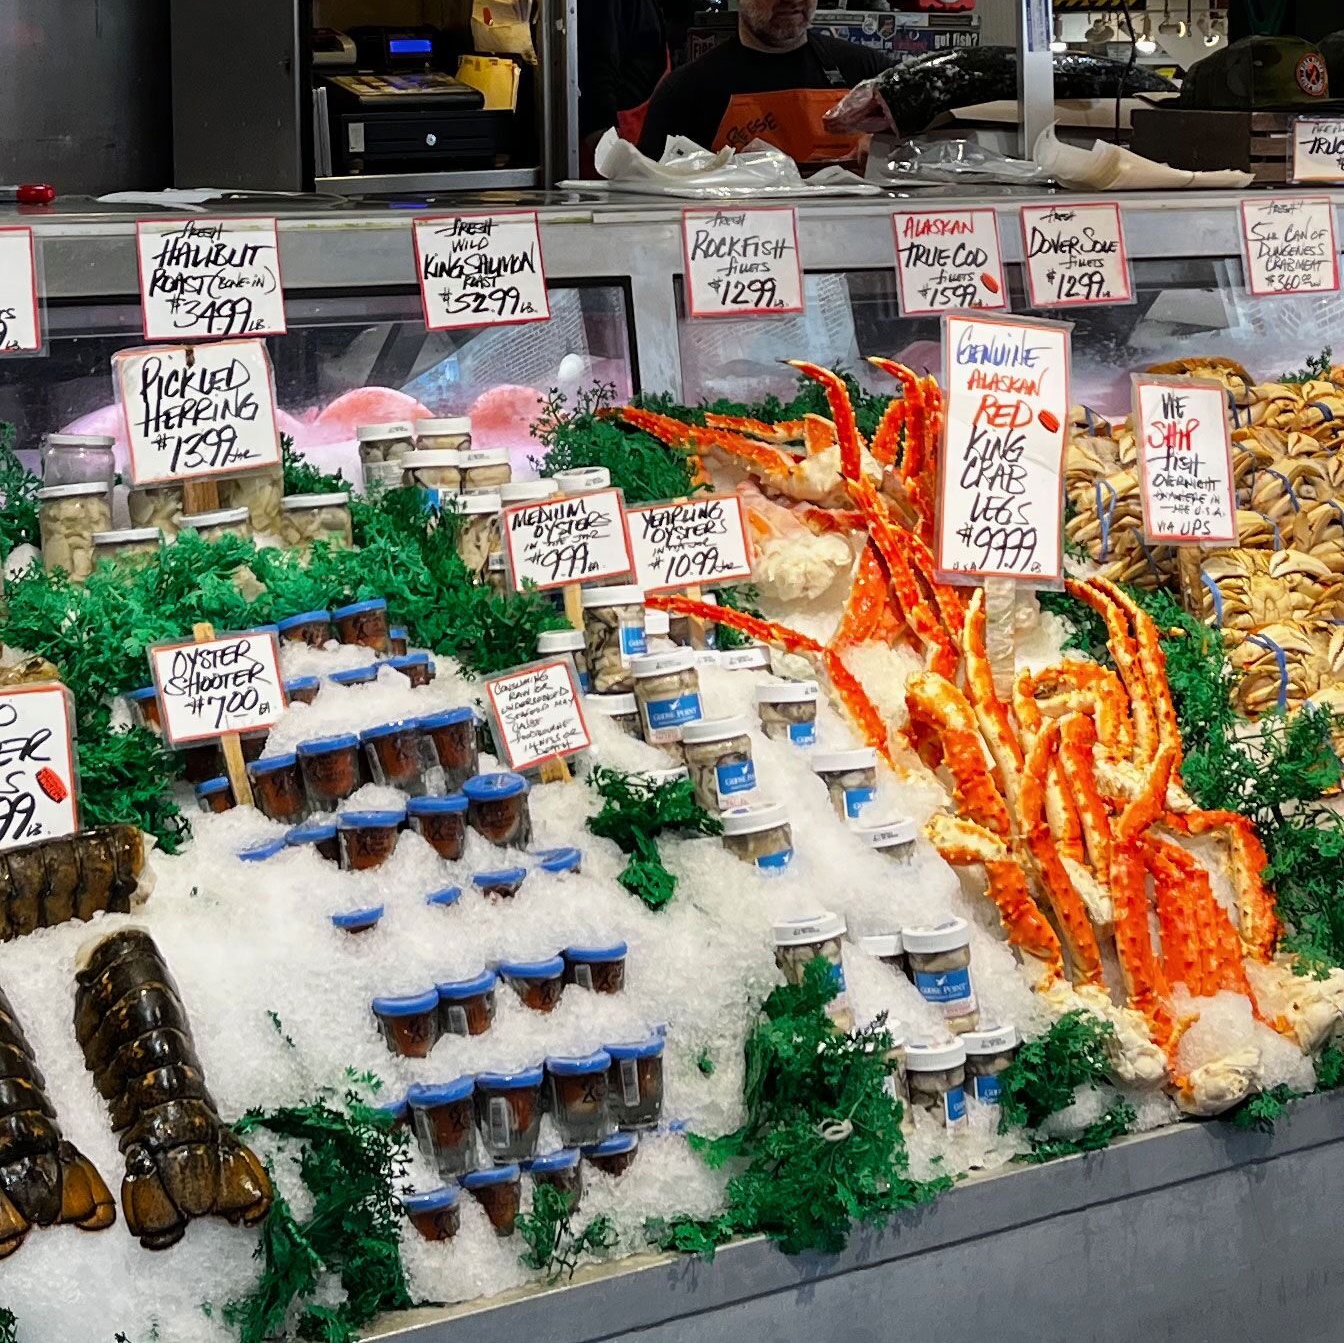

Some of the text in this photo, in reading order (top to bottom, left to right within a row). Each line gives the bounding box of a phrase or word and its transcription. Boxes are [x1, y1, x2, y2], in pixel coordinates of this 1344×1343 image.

[902, 212, 975, 239] ALASKAN
[1027, 225, 1120, 259] DOVER SOLE
[152, 242, 276, 270] HALIBUT
[423, 240, 537, 281] KING SALMON
[451, 235, 490, 253] WILD
[690, 228, 796, 261] ROCKFISH
[898, 242, 988, 269] TRUE COD
[1256, 240, 1325, 260] DUNGENESS
[438, 286, 522, 316] $52.99
[967, 366, 1050, 398] ALASKAN
[972, 393, 1034, 429] RED
[1161, 393, 1190, 419] WE
[963, 422, 1027, 463] KING
[959, 455, 1028, 495] CRAB
[1152, 473, 1221, 492] OVERNIGHT
[512, 498, 586, 532] MEDIUM
[641, 501, 724, 540] YEARLING
[969, 491, 1033, 526] LEGS
[533, 510, 613, 542] OYSTERS
[650, 518, 728, 545] OYSTERS
[1180, 517, 1213, 536] UPS
[524, 543, 590, 581] $9.99
[648, 545, 719, 585] $10.99
[171, 639, 252, 676] OYSTER
[163, 663, 273, 697] SHOOTER
